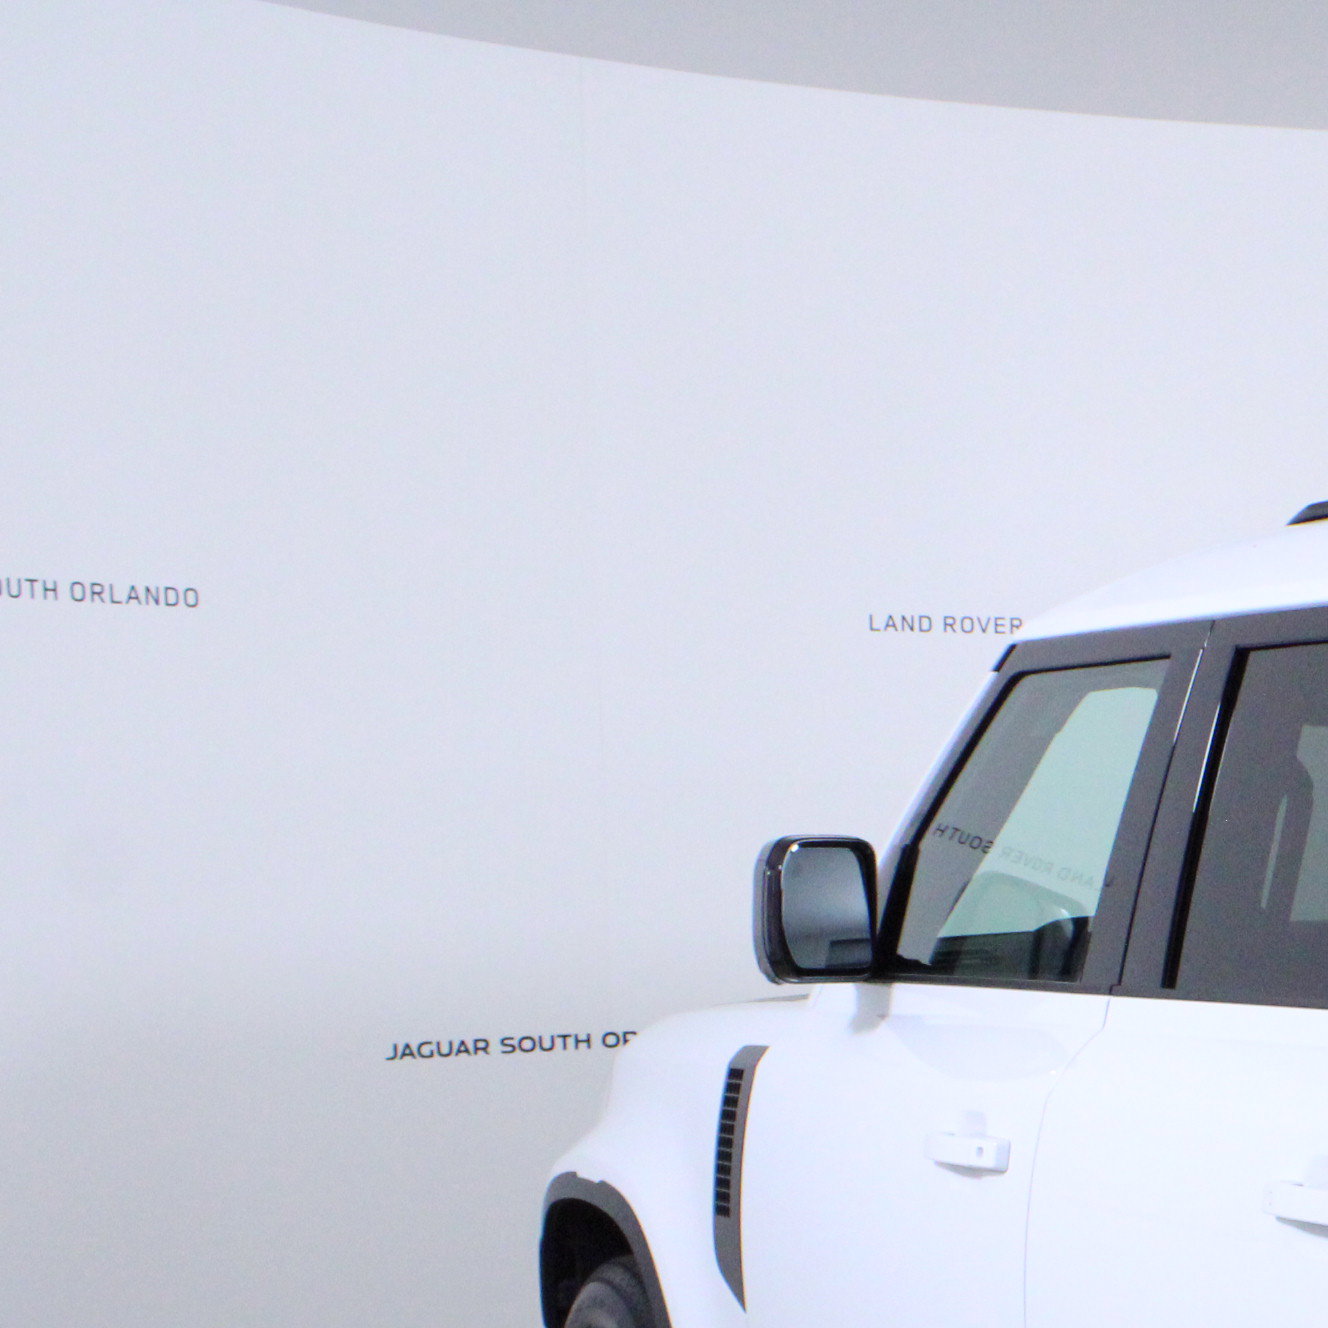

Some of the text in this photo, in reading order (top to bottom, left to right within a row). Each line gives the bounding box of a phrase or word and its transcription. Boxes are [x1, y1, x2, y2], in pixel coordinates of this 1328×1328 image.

[0, 577, 199, 608] UTH ORLANDO
[869, 614, 1023, 635] LAND ROVER
[385, 1038, 490, 1061] JAGUAR
[500, 1033, 592, 1055] SOUTH
